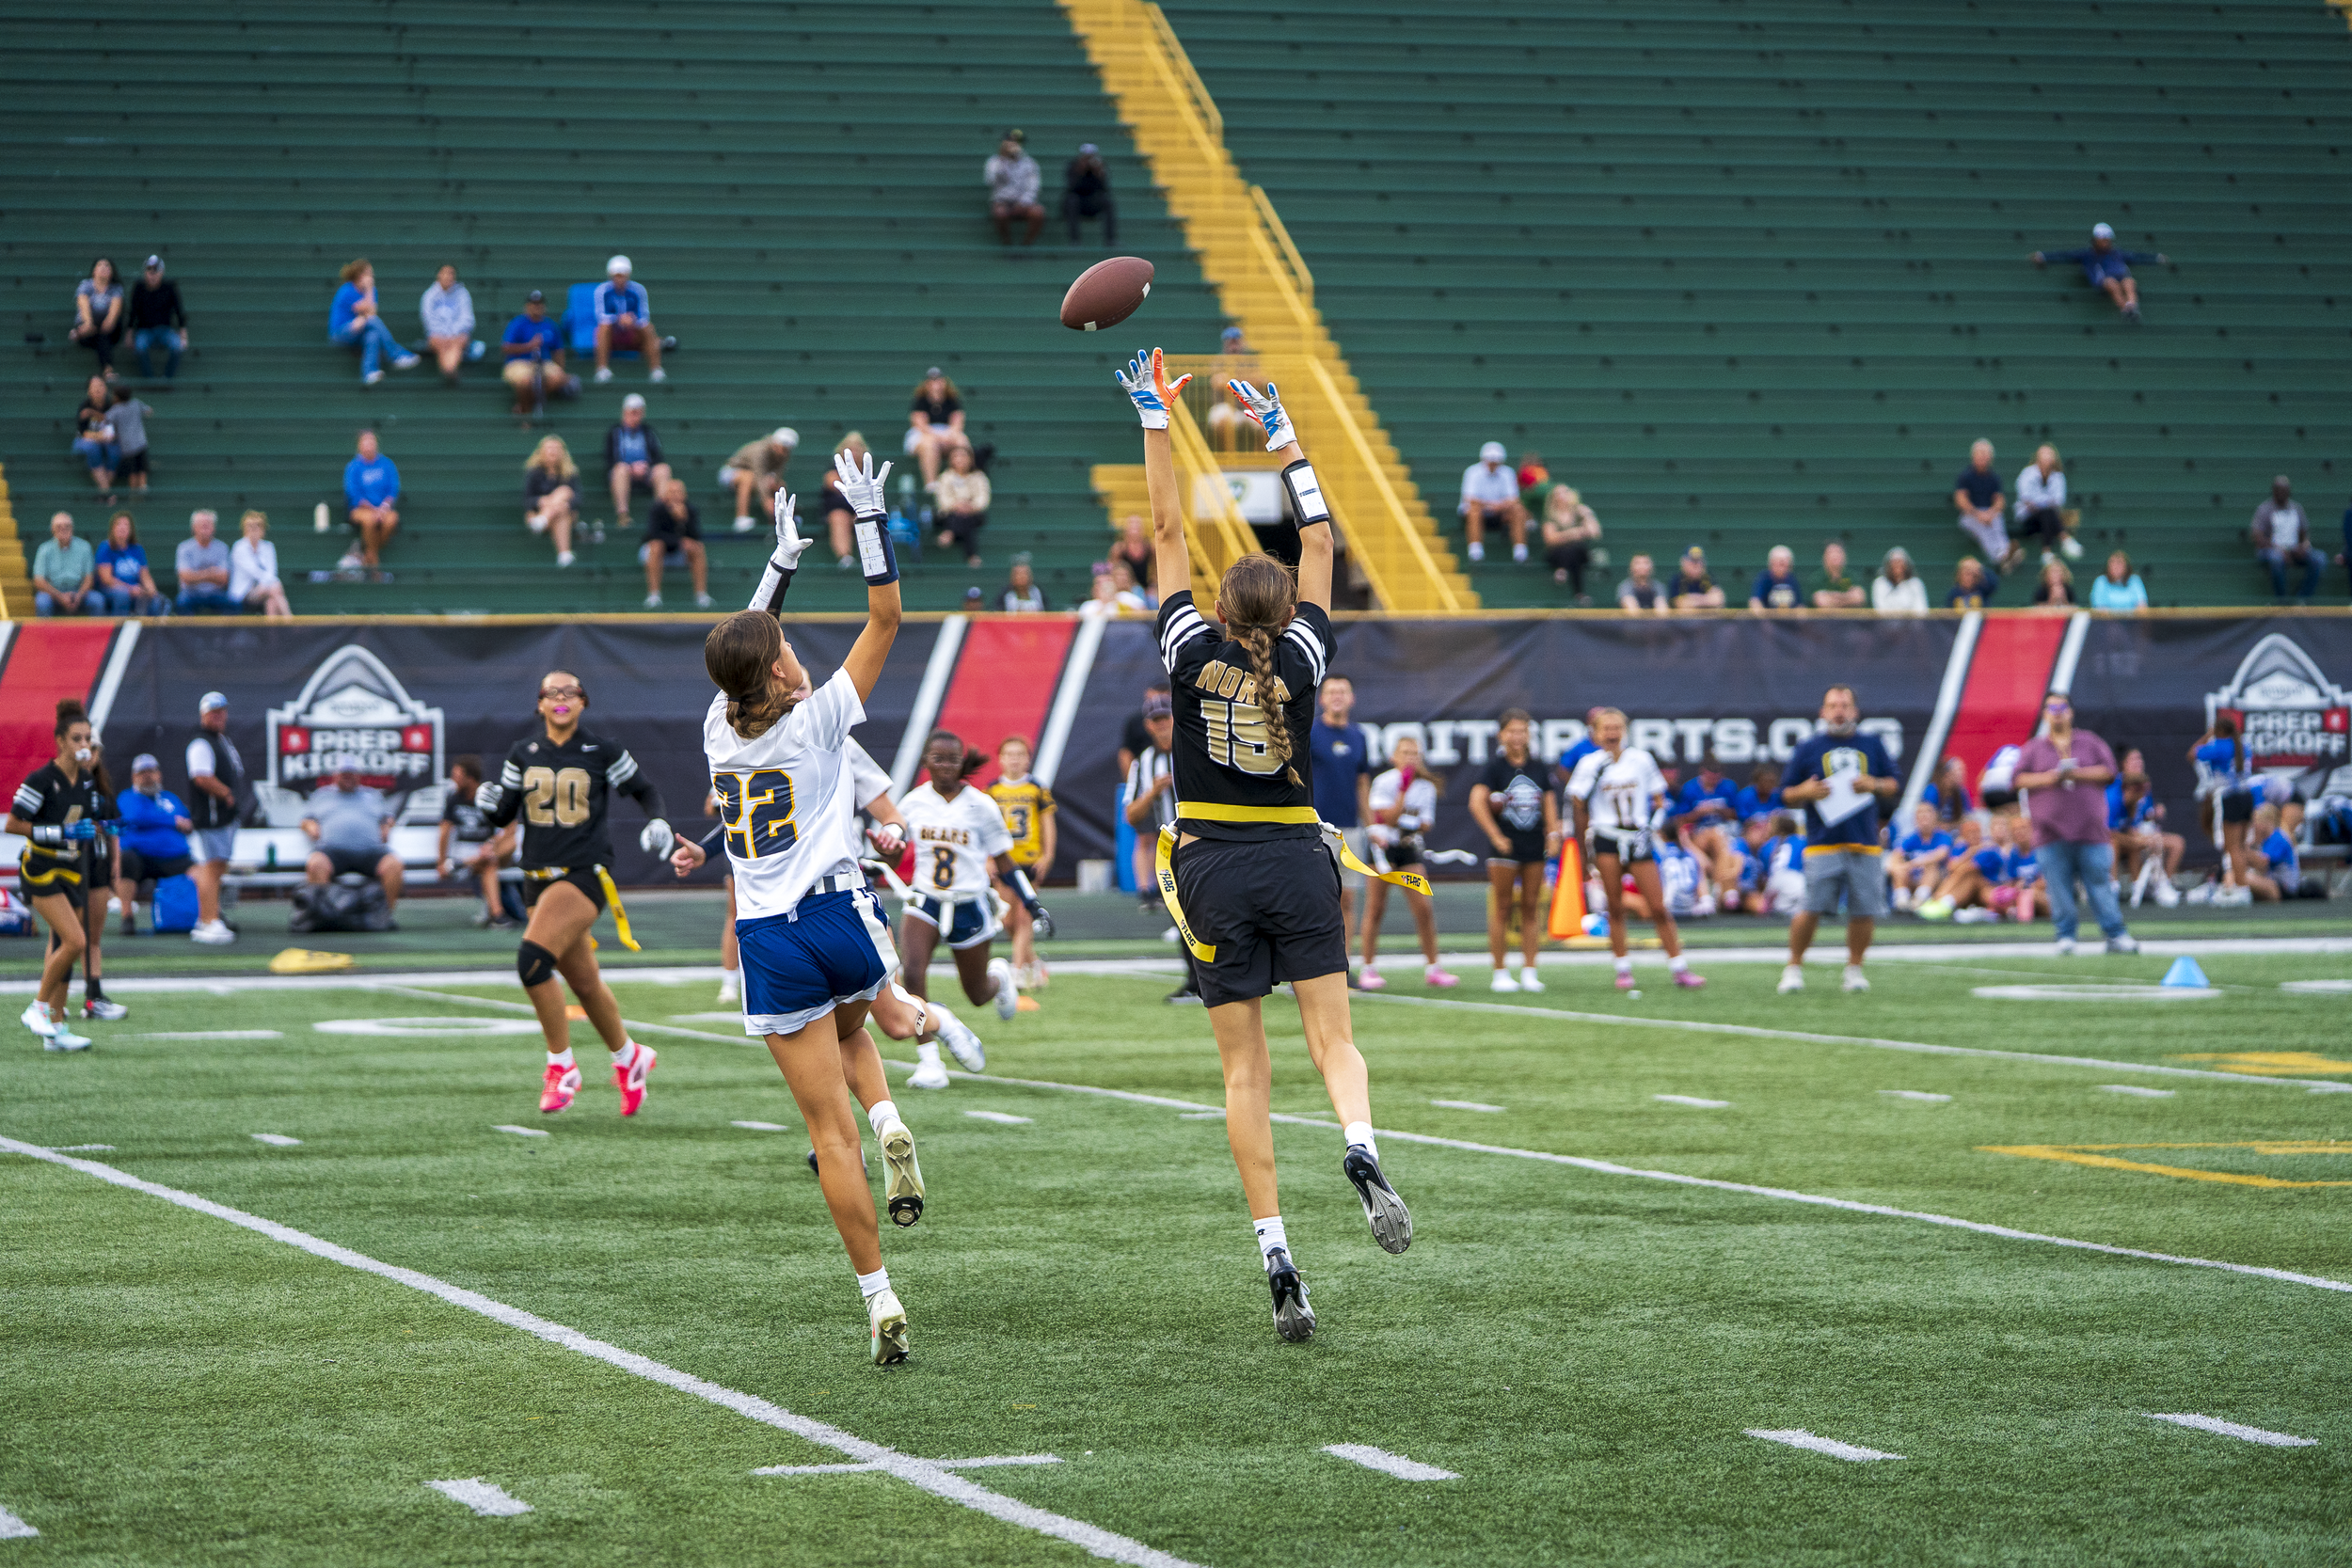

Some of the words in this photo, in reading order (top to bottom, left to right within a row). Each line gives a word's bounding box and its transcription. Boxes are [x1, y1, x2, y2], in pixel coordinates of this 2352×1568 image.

[1195, 659, 1292, 705] NORH
[2245, 712, 2322, 732] PREP
[311, 729, 402, 752] PREP
[1200, 699, 1284, 774] 15
[523, 766, 592, 828] 20
[713, 769, 799, 860] 22
[921, 825, 970, 846] BEARS
[932, 847, 956, 890] 8
[1160, 872, 1175, 892] FLAG
[1406, 875, 1422, 887] FLAG
[1182, 925, 1197, 947] FLAG
